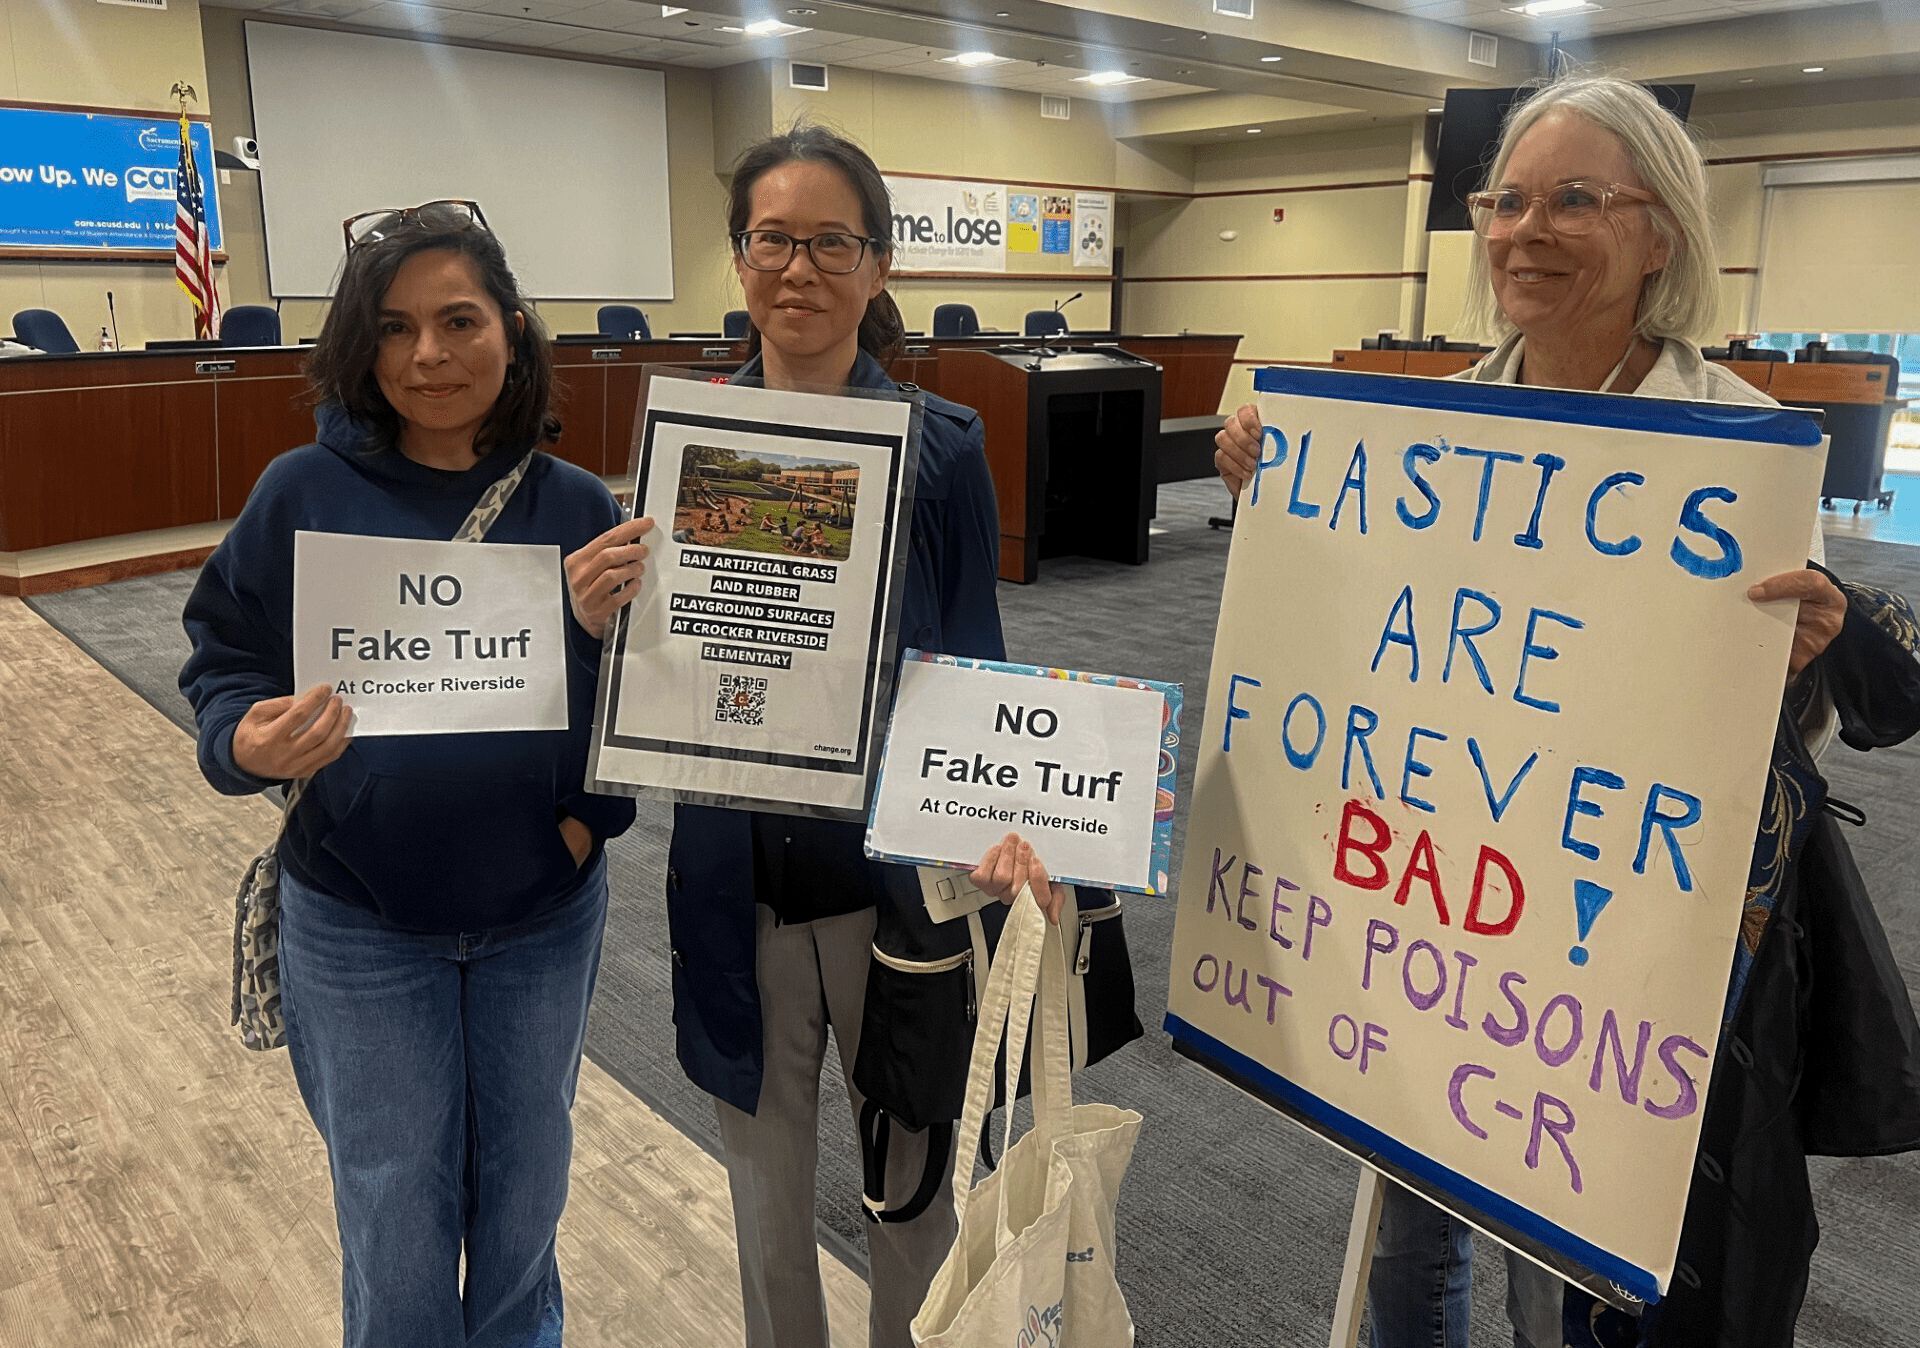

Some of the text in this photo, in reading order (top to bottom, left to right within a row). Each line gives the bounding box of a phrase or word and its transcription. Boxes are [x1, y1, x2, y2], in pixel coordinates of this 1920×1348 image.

[39, 165, 77, 188] Up.
[82, 167, 118, 187] We
[934, 231, 945, 243] to
[946, 206, 1002, 246] lose
[1251, 424, 1743, 579] PLASTICS
[682, 553, 835, 581] BAN ARTIFICIAL GRASS
[400, 573, 463, 607] NO
[712, 579, 798, 599] AND RUBBER
[672, 597, 833, 626] PLAYGROUND SURFACES
[331, 628, 532, 661] Fake Turf
[672, 620, 827, 648] AT CROCKER RIVERSIDE
[1371, 584, 1586, 713] ARE
[703, 646, 791, 666] ELEMENTARY
[335, 676, 526, 695] At Crocker Riverside
[994, 703, 1059, 738] NO
[814, 744, 852, 756] change.org
[920, 747, 1123, 802] Fake Turf
[1222, 674, 1703, 892] FOREVER
[919, 797, 1109, 835] At Crocker Riverside
[1333, 799, 1526, 936] BAD
[1206, 846, 1709, 1120] KEEP POISONS
[1192, 953, 1584, 1194] OUT OF C-R
